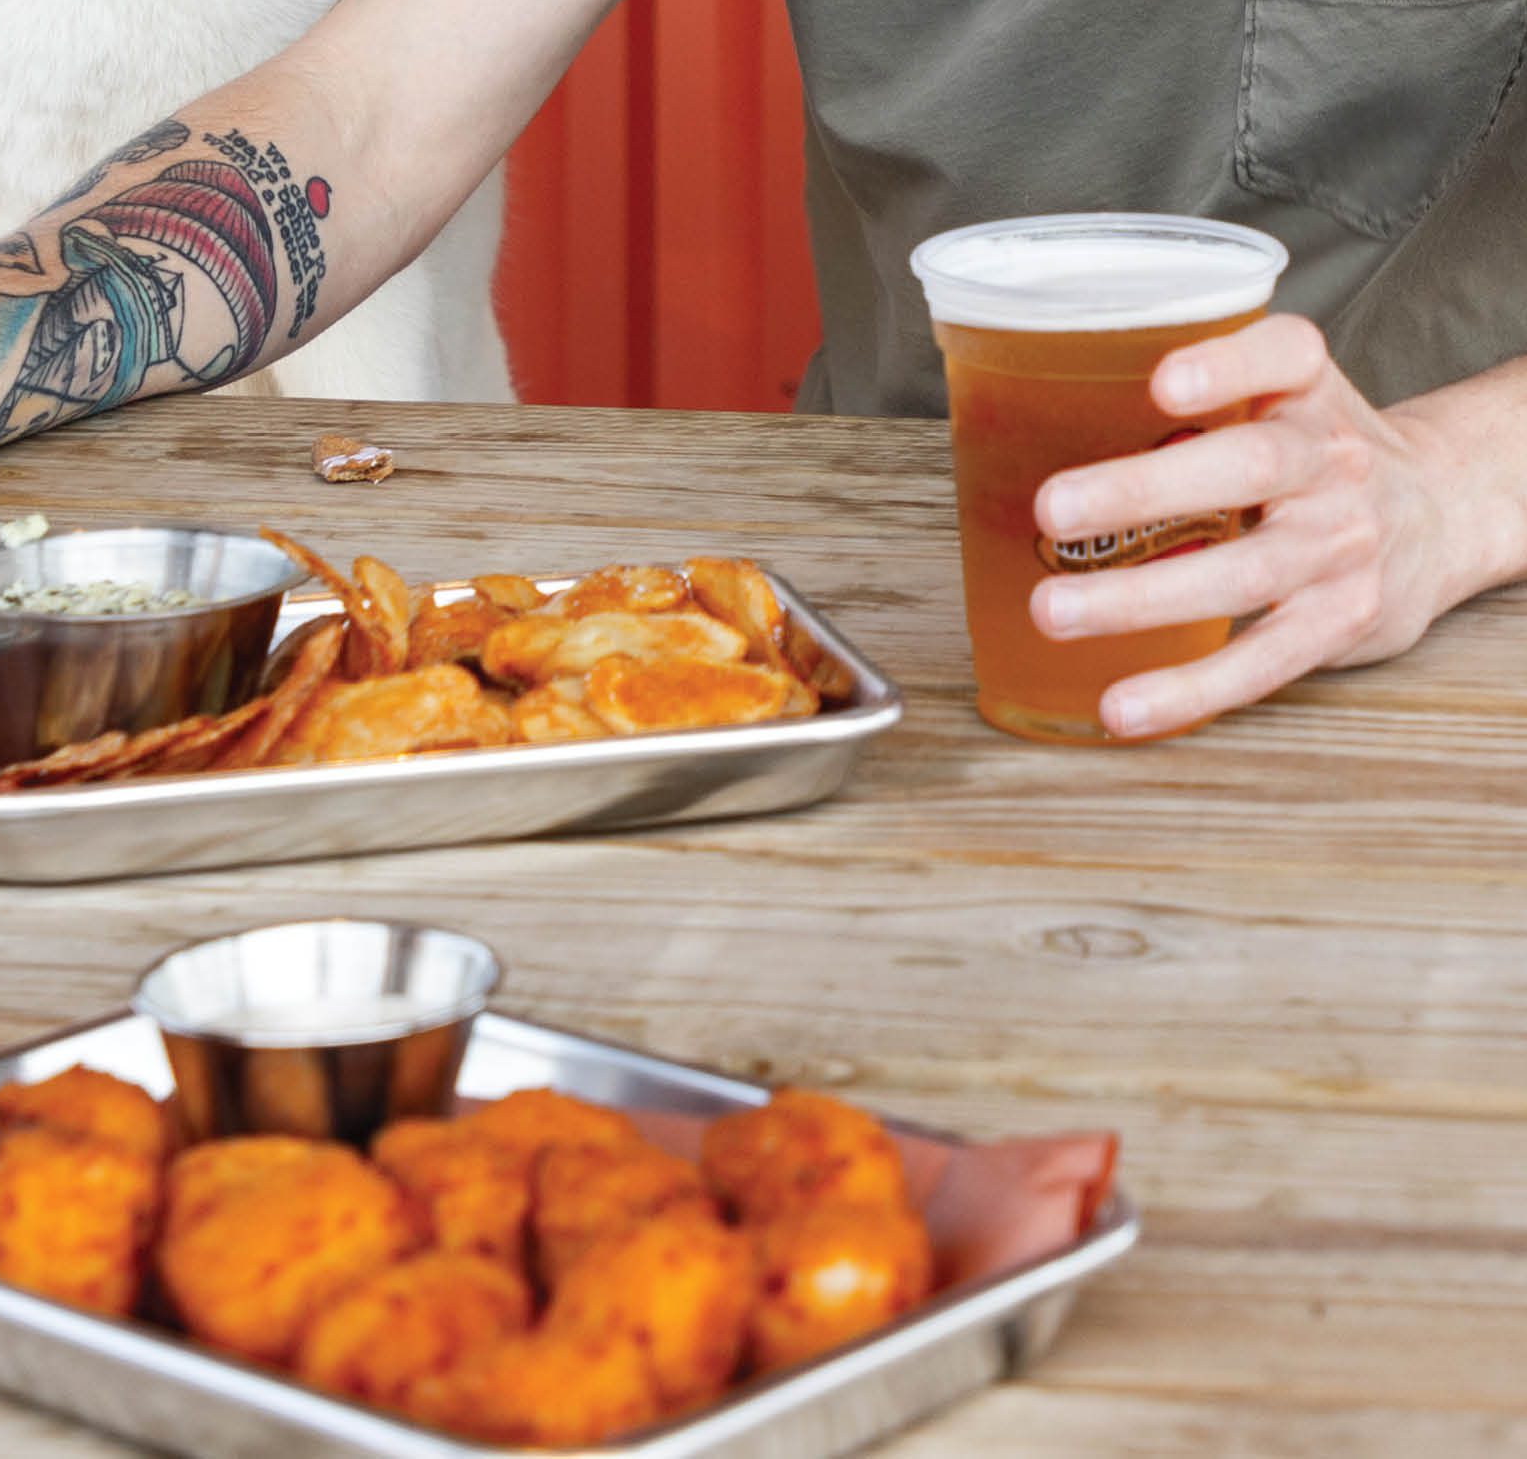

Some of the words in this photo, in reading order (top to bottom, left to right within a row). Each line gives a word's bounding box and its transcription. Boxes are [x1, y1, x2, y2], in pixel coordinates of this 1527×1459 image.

[201, 132, 265, 184] world
[261, 189, 276, 206] a
[273, 205, 303, 285] better
[223, 128, 278, 184] leave
[277, 183, 315, 275] behind
[290, 183, 321, 250] came
